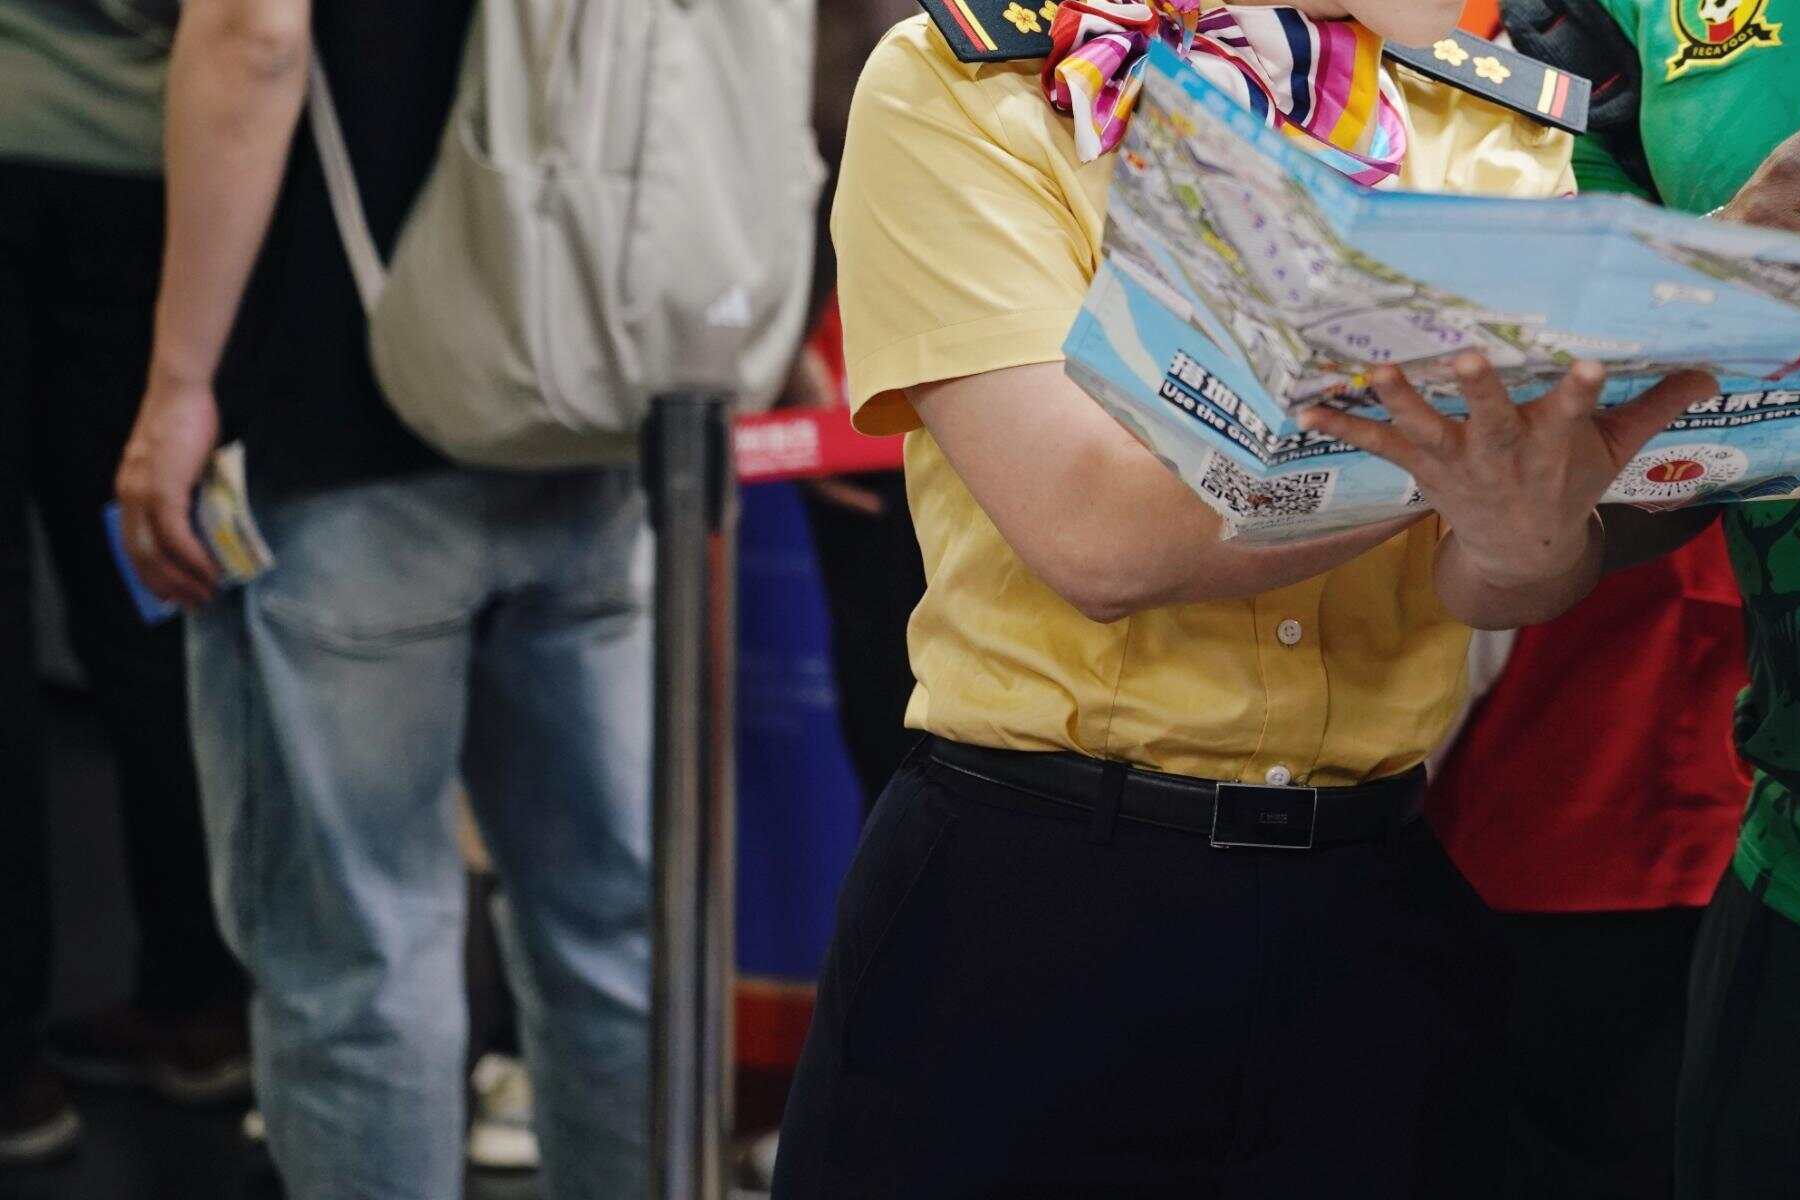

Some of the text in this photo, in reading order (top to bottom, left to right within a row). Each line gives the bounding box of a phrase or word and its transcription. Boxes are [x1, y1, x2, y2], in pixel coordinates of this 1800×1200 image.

[1692, 27, 1755, 57] FECAFOOT
[1161, 381, 1196, 411] Use
[1196, 403, 1227, 430] the
[1688, 415, 1728, 428] and
[1728, 411, 1763, 427] bus
